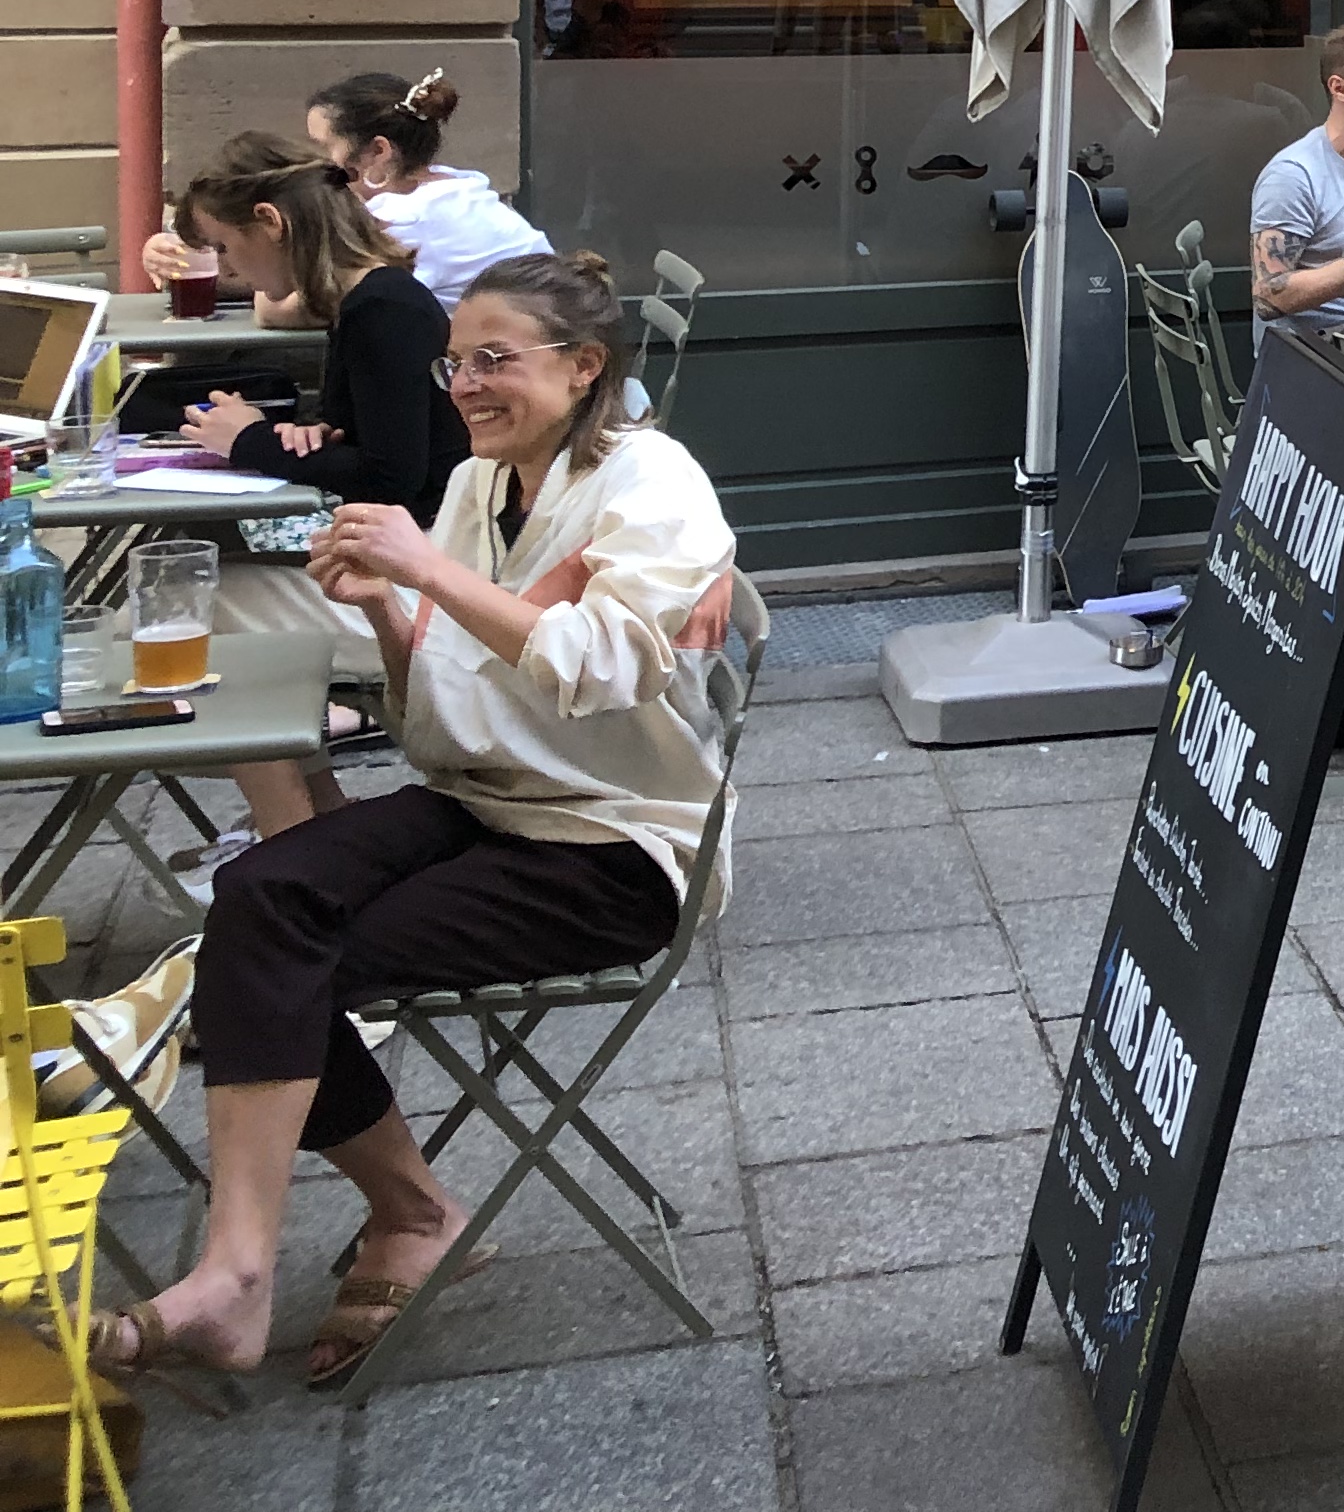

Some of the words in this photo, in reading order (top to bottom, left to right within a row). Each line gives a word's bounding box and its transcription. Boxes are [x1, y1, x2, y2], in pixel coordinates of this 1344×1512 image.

[1240, 415, 1307, 541] HAPPY
[1178, 670, 1257, 823] CUISINE
[1237, 797, 1283, 871] CONTINU
[1103, 947, 1152, 1072] MAIS
[1134, 1005, 1198, 1159] AUSSI
